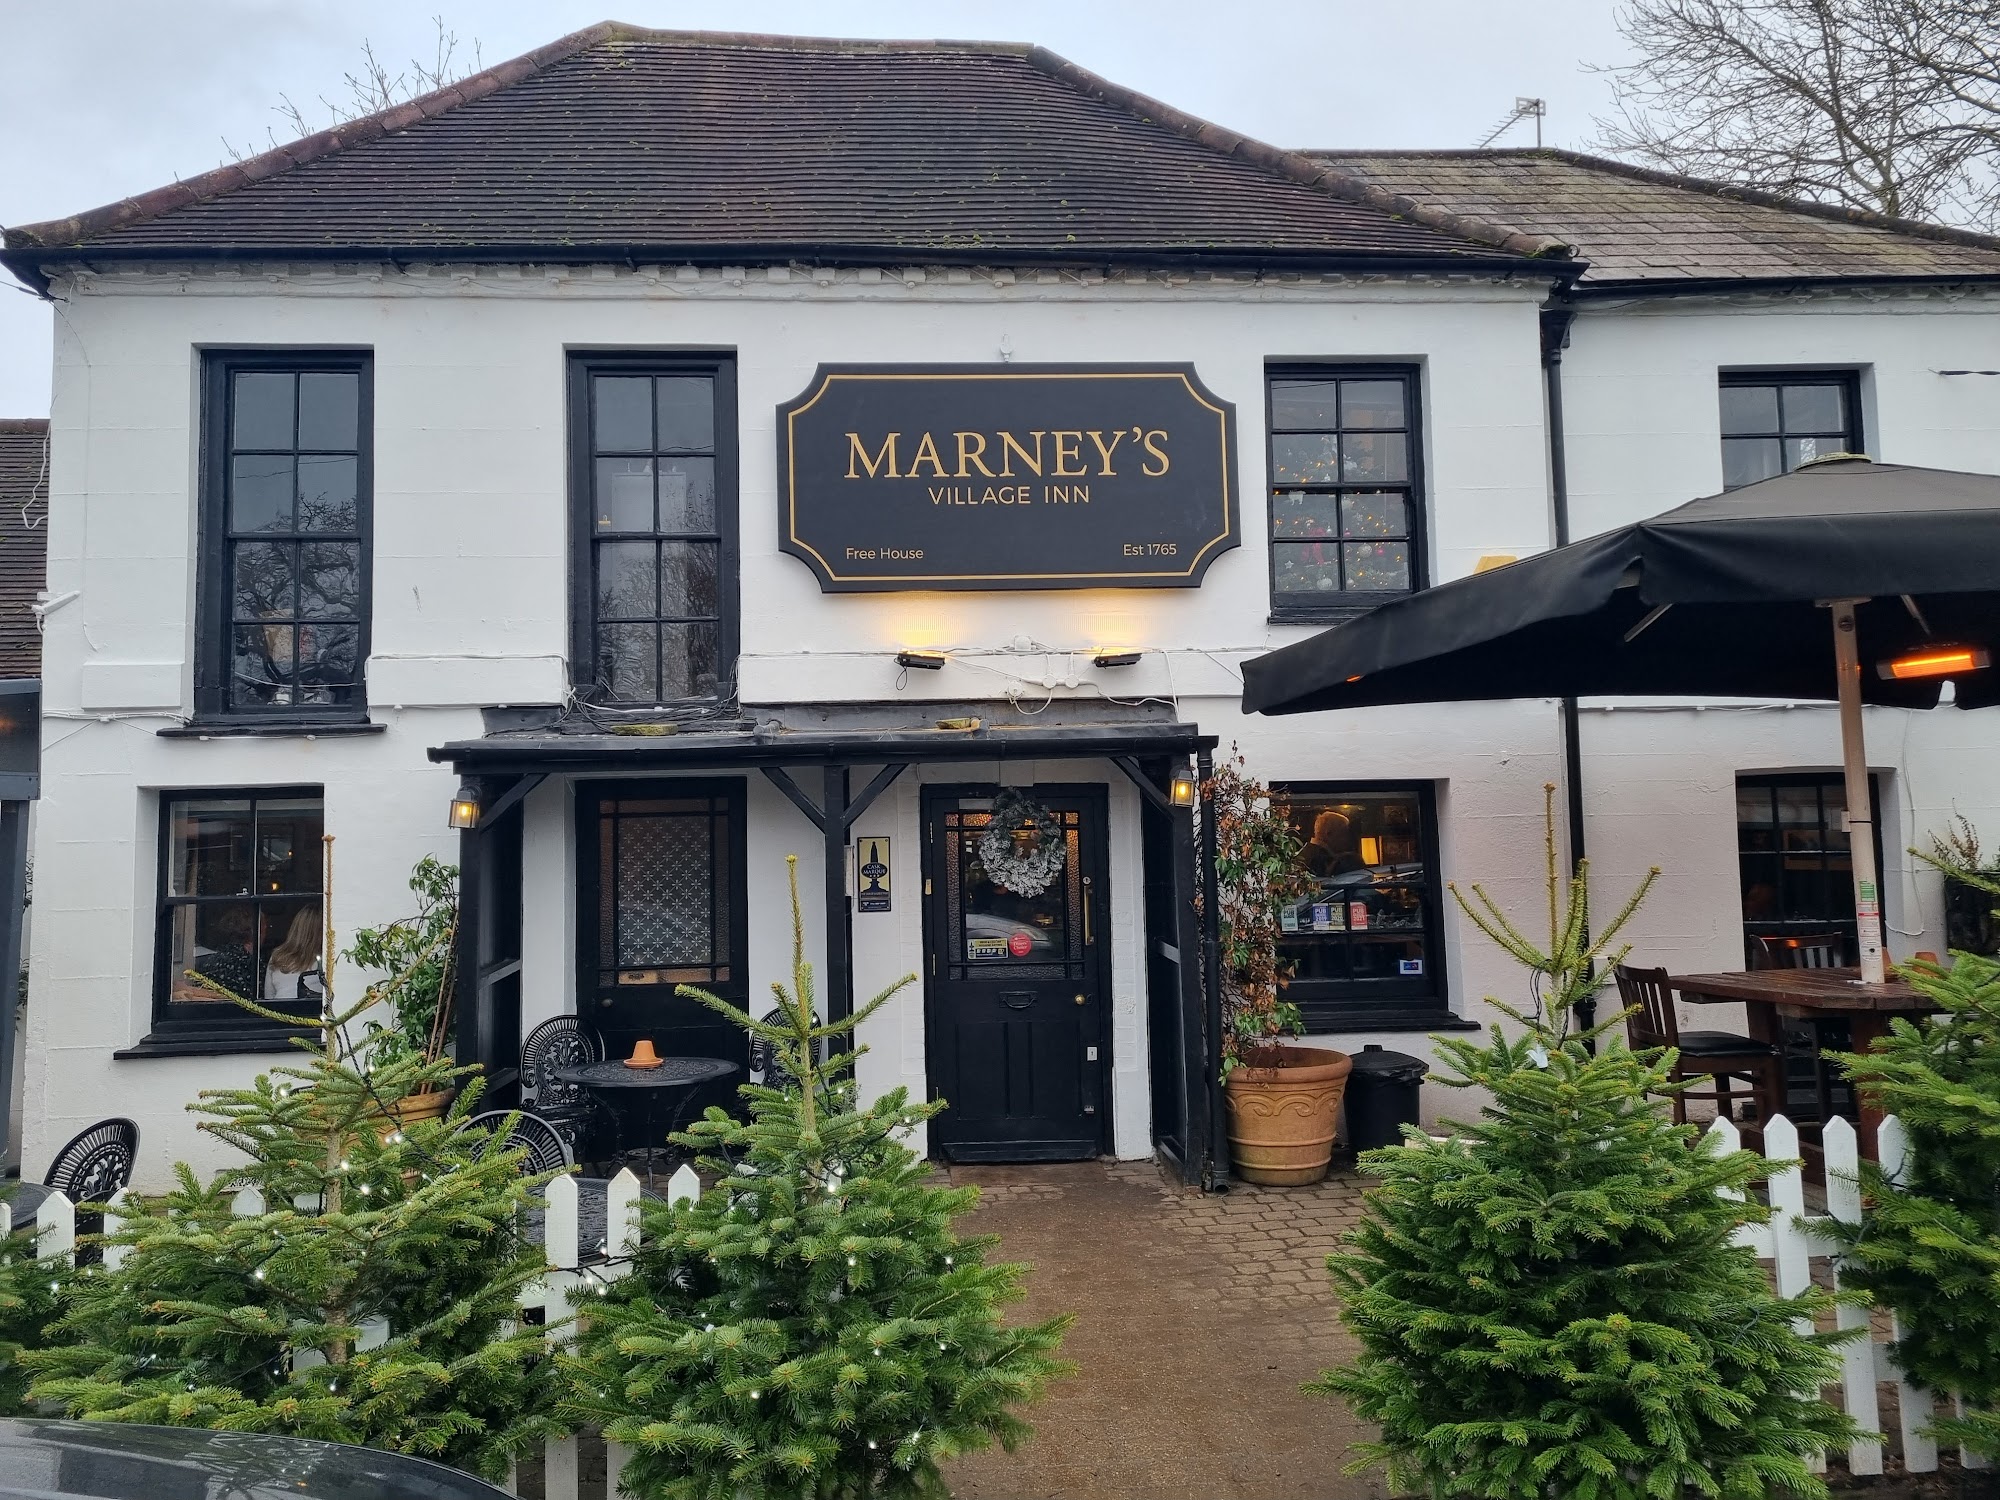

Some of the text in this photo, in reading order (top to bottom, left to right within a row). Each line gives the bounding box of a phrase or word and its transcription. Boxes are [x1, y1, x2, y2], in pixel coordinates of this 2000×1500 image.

[928, 485, 1090, 505] VILLAGE INN
[846, 547, 924, 560] Free House
[1123, 543, 1177, 556] Est 1765
